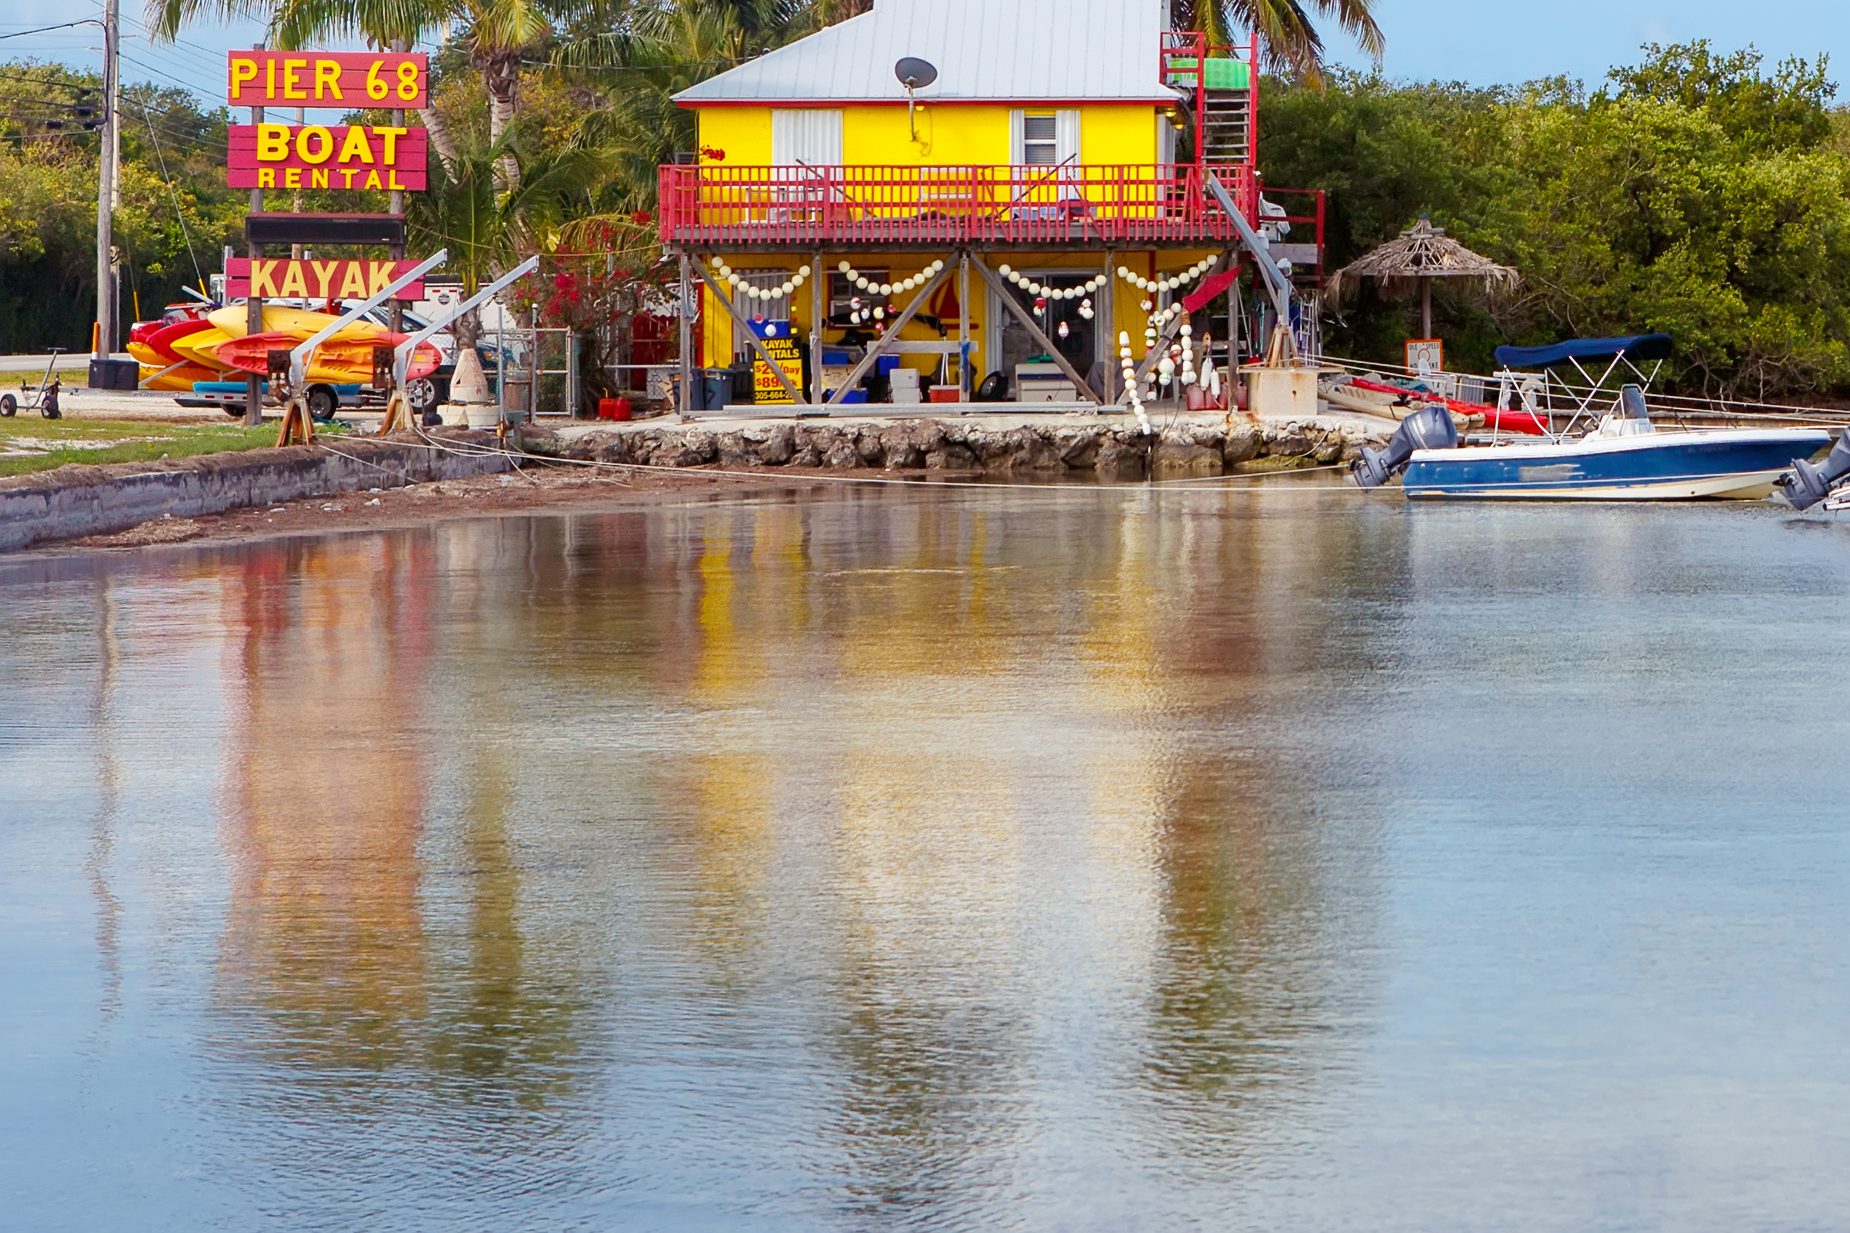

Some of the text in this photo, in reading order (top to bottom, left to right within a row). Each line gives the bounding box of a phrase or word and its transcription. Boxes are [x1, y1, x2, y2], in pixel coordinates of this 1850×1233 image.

[231, 58, 419, 101] PIER 68
[257, 122, 407, 166] BOAT
[258, 167, 406, 190] RENTAL
[250, 260, 398, 298] KAYAK
[761, 339, 793, 349] KAYAK
